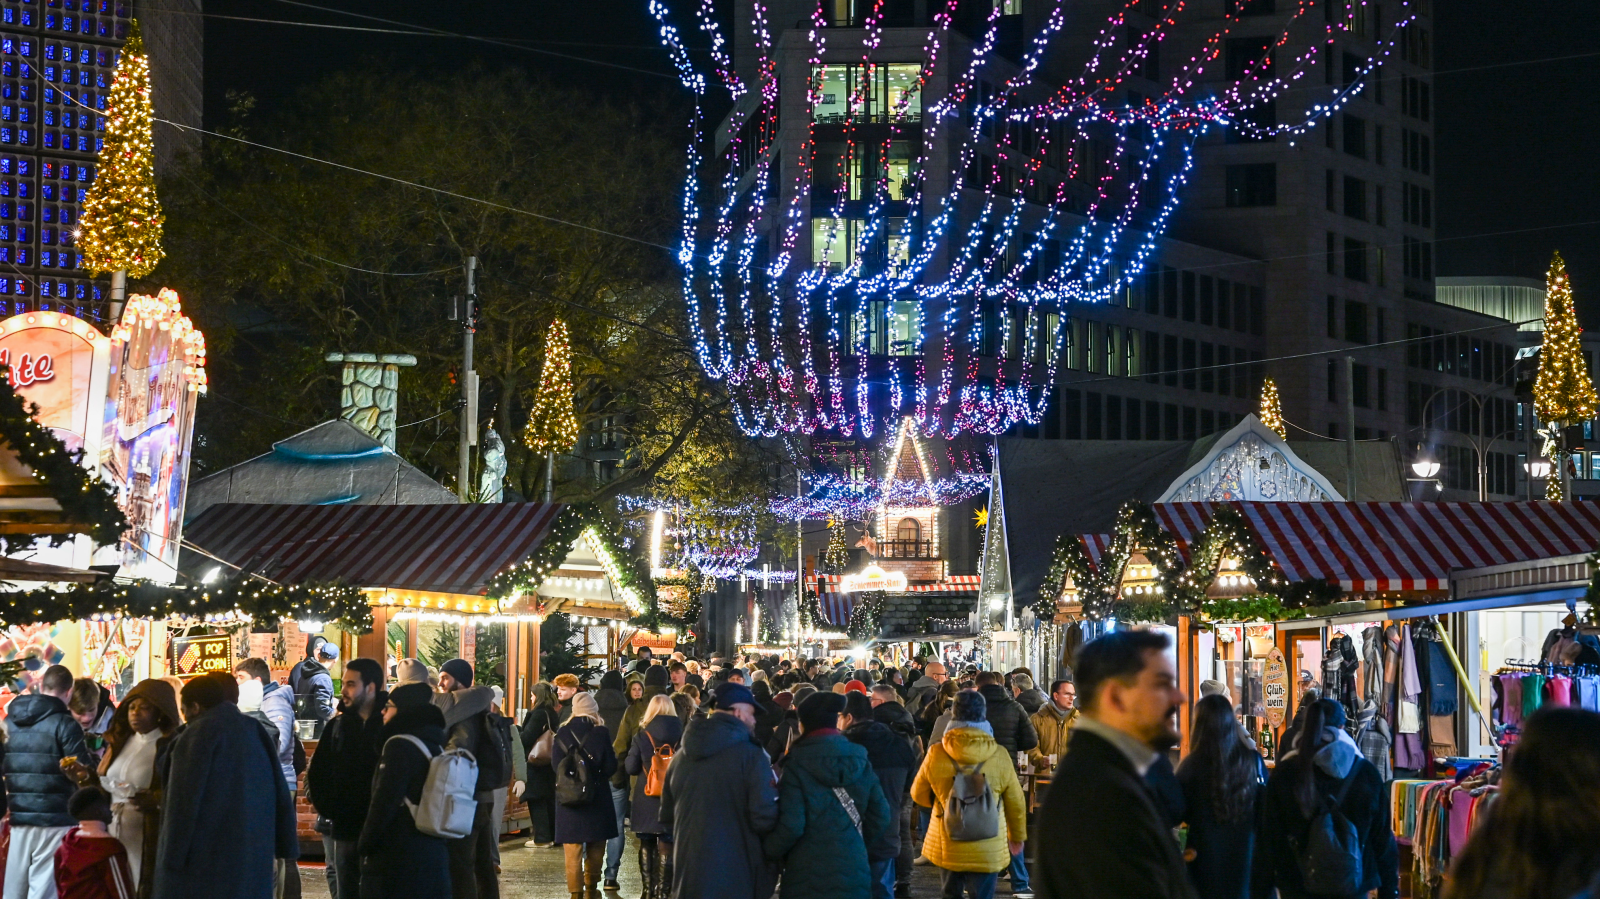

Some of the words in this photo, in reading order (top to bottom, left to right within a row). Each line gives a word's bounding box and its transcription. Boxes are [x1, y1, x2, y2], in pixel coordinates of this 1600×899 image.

[205, 643, 224, 655] POP
[202, 657, 227, 670] CORN
[1266, 684, 1285, 697] Glüh-
[1267, 697, 1284, 707] wein
